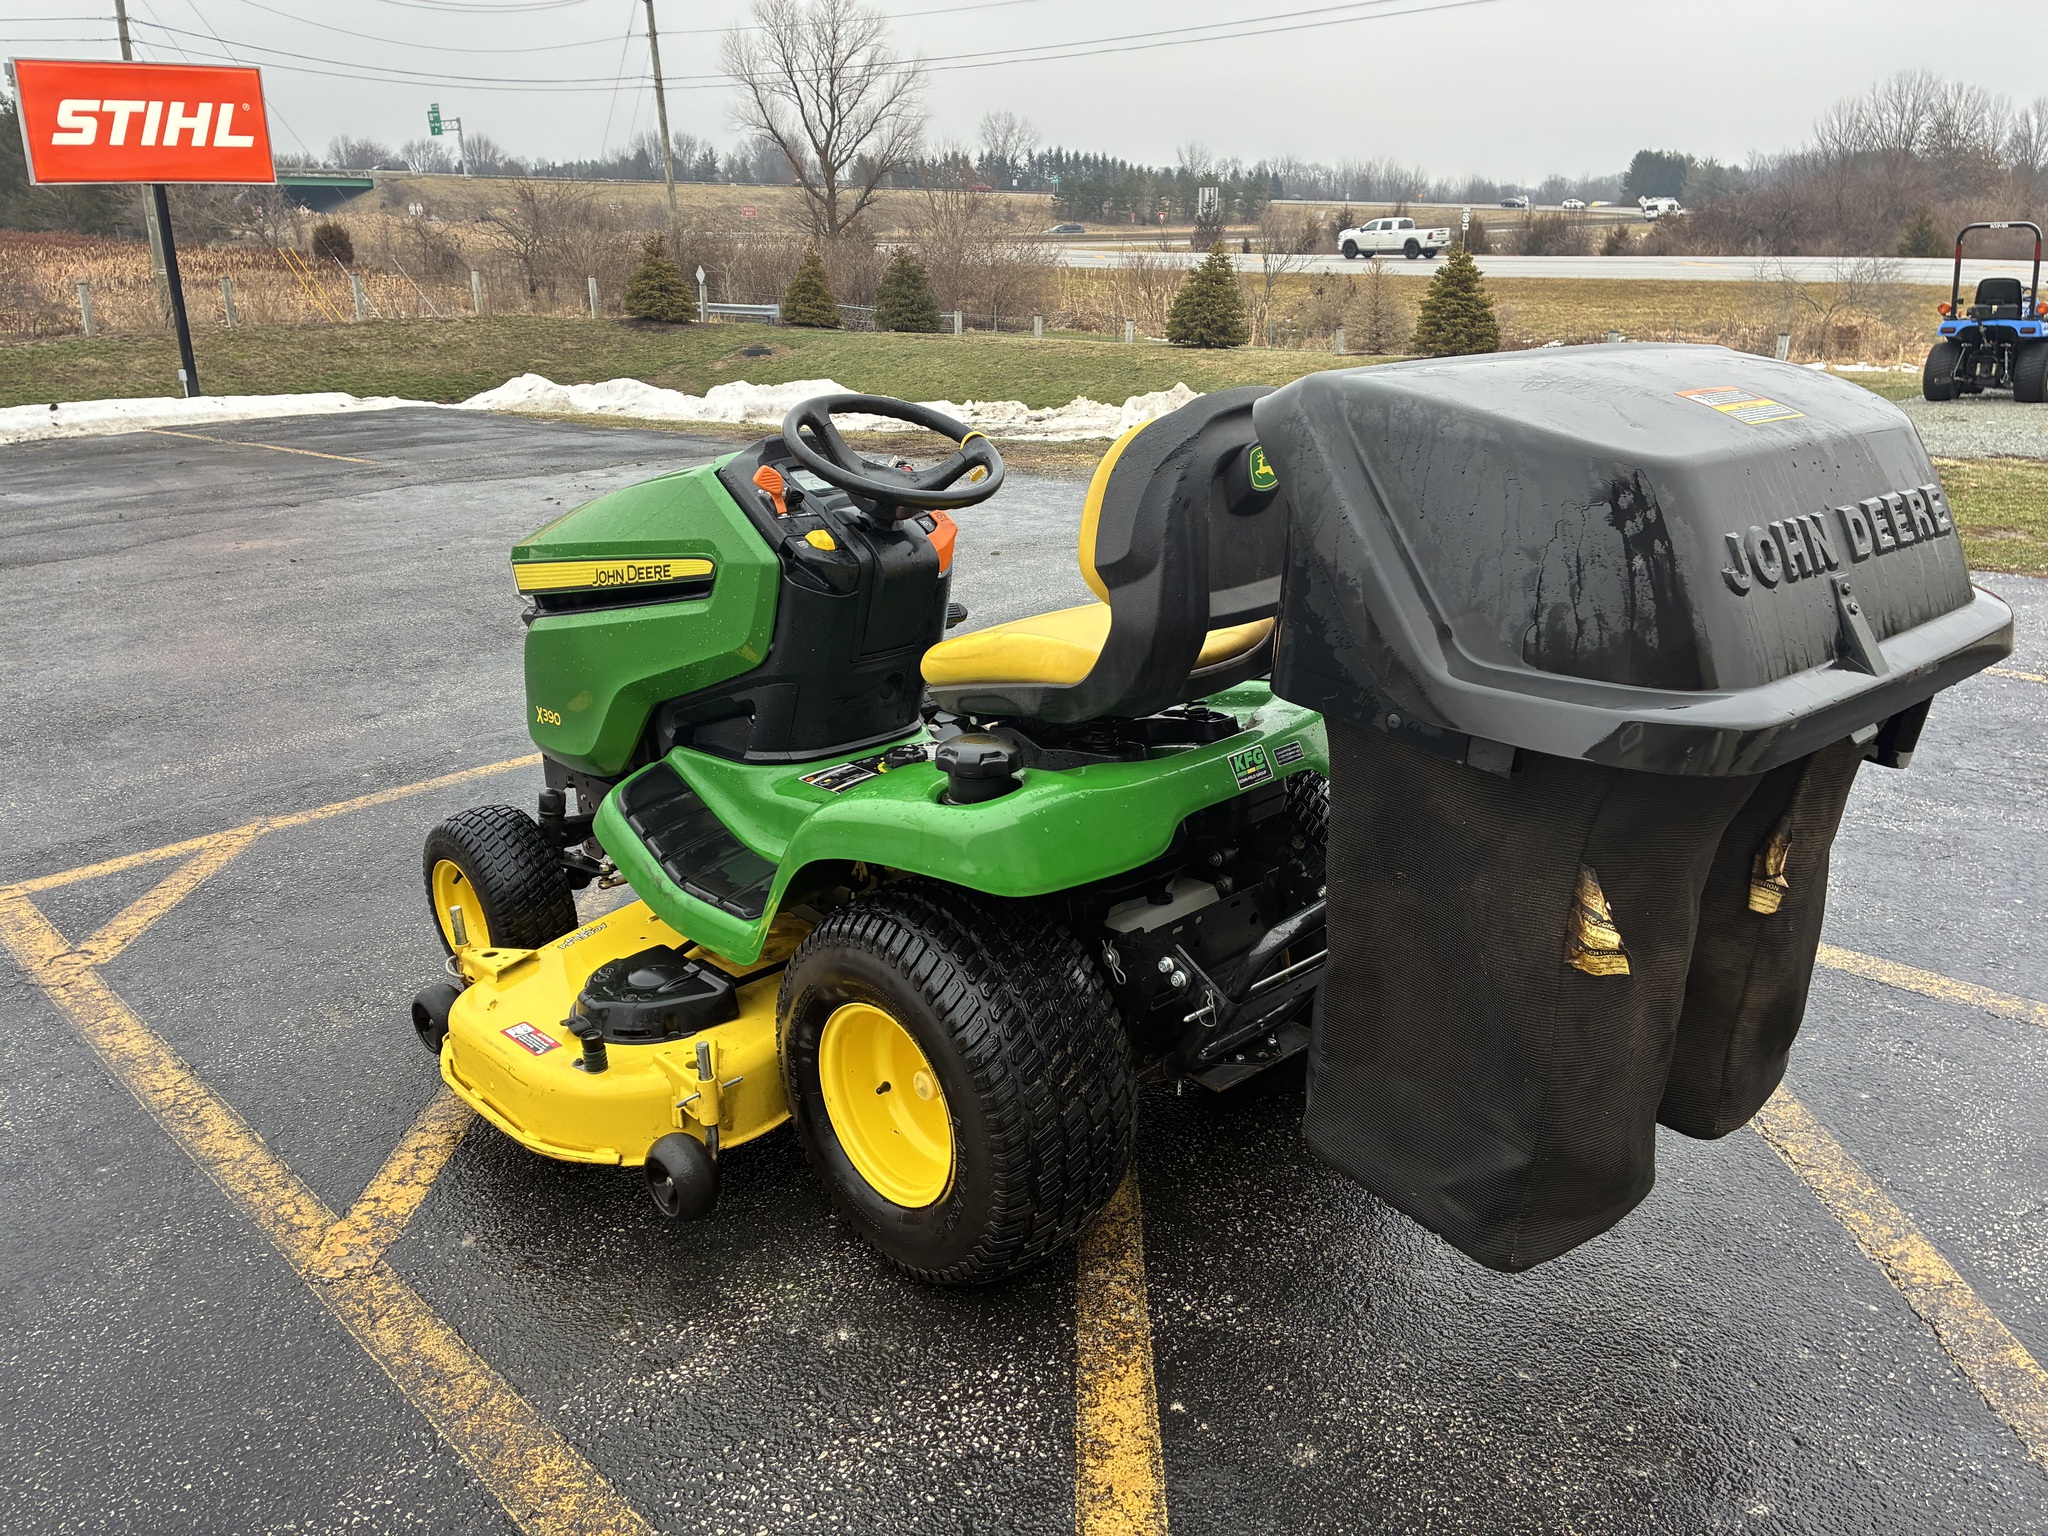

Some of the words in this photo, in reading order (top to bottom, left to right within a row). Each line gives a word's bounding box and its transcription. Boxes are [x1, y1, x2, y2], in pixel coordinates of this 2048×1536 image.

[51, 99, 254, 147] STIHL
[1721, 511, 1839, 597] JOHN
[1835, 482, 1952, 563] DEERE
[592, 568, 625, 585] JOHN
[626, 564, 672, 582] DEERE
[535, 705, 561, 726] X390
[1233, 748, 1264, 773] KFG
